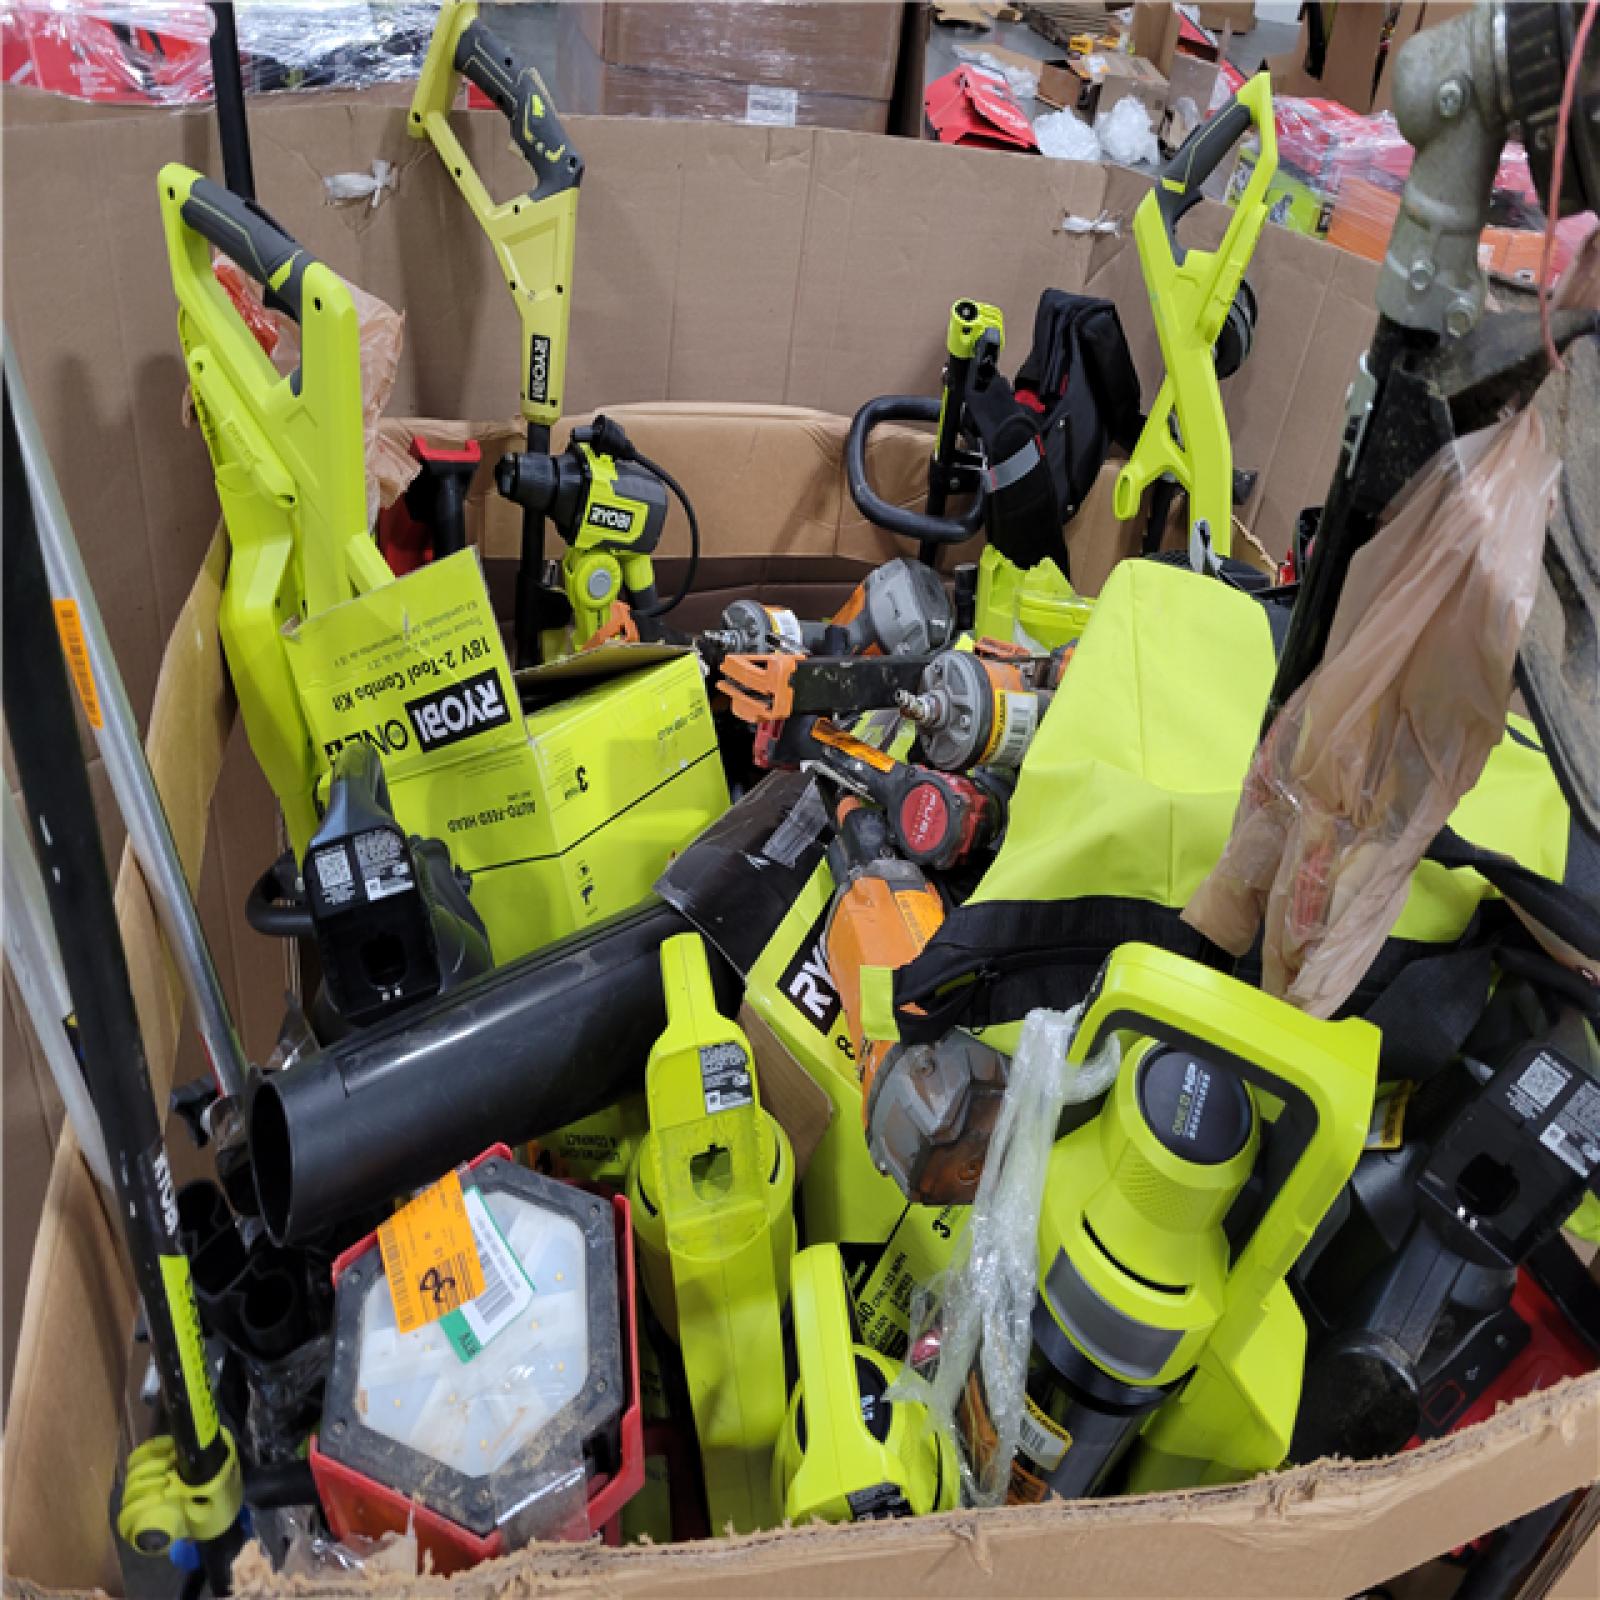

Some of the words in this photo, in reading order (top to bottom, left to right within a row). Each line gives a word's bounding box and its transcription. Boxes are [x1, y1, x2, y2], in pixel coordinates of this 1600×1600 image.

[589, 507, 632, 532] RYOBI
[408, 647, 458, 683] 2-Tool
[461, 635, 491, 664] 18V
[355, 670, 406, 702] Combo
[413, 678, 505, 742] RYOBI
